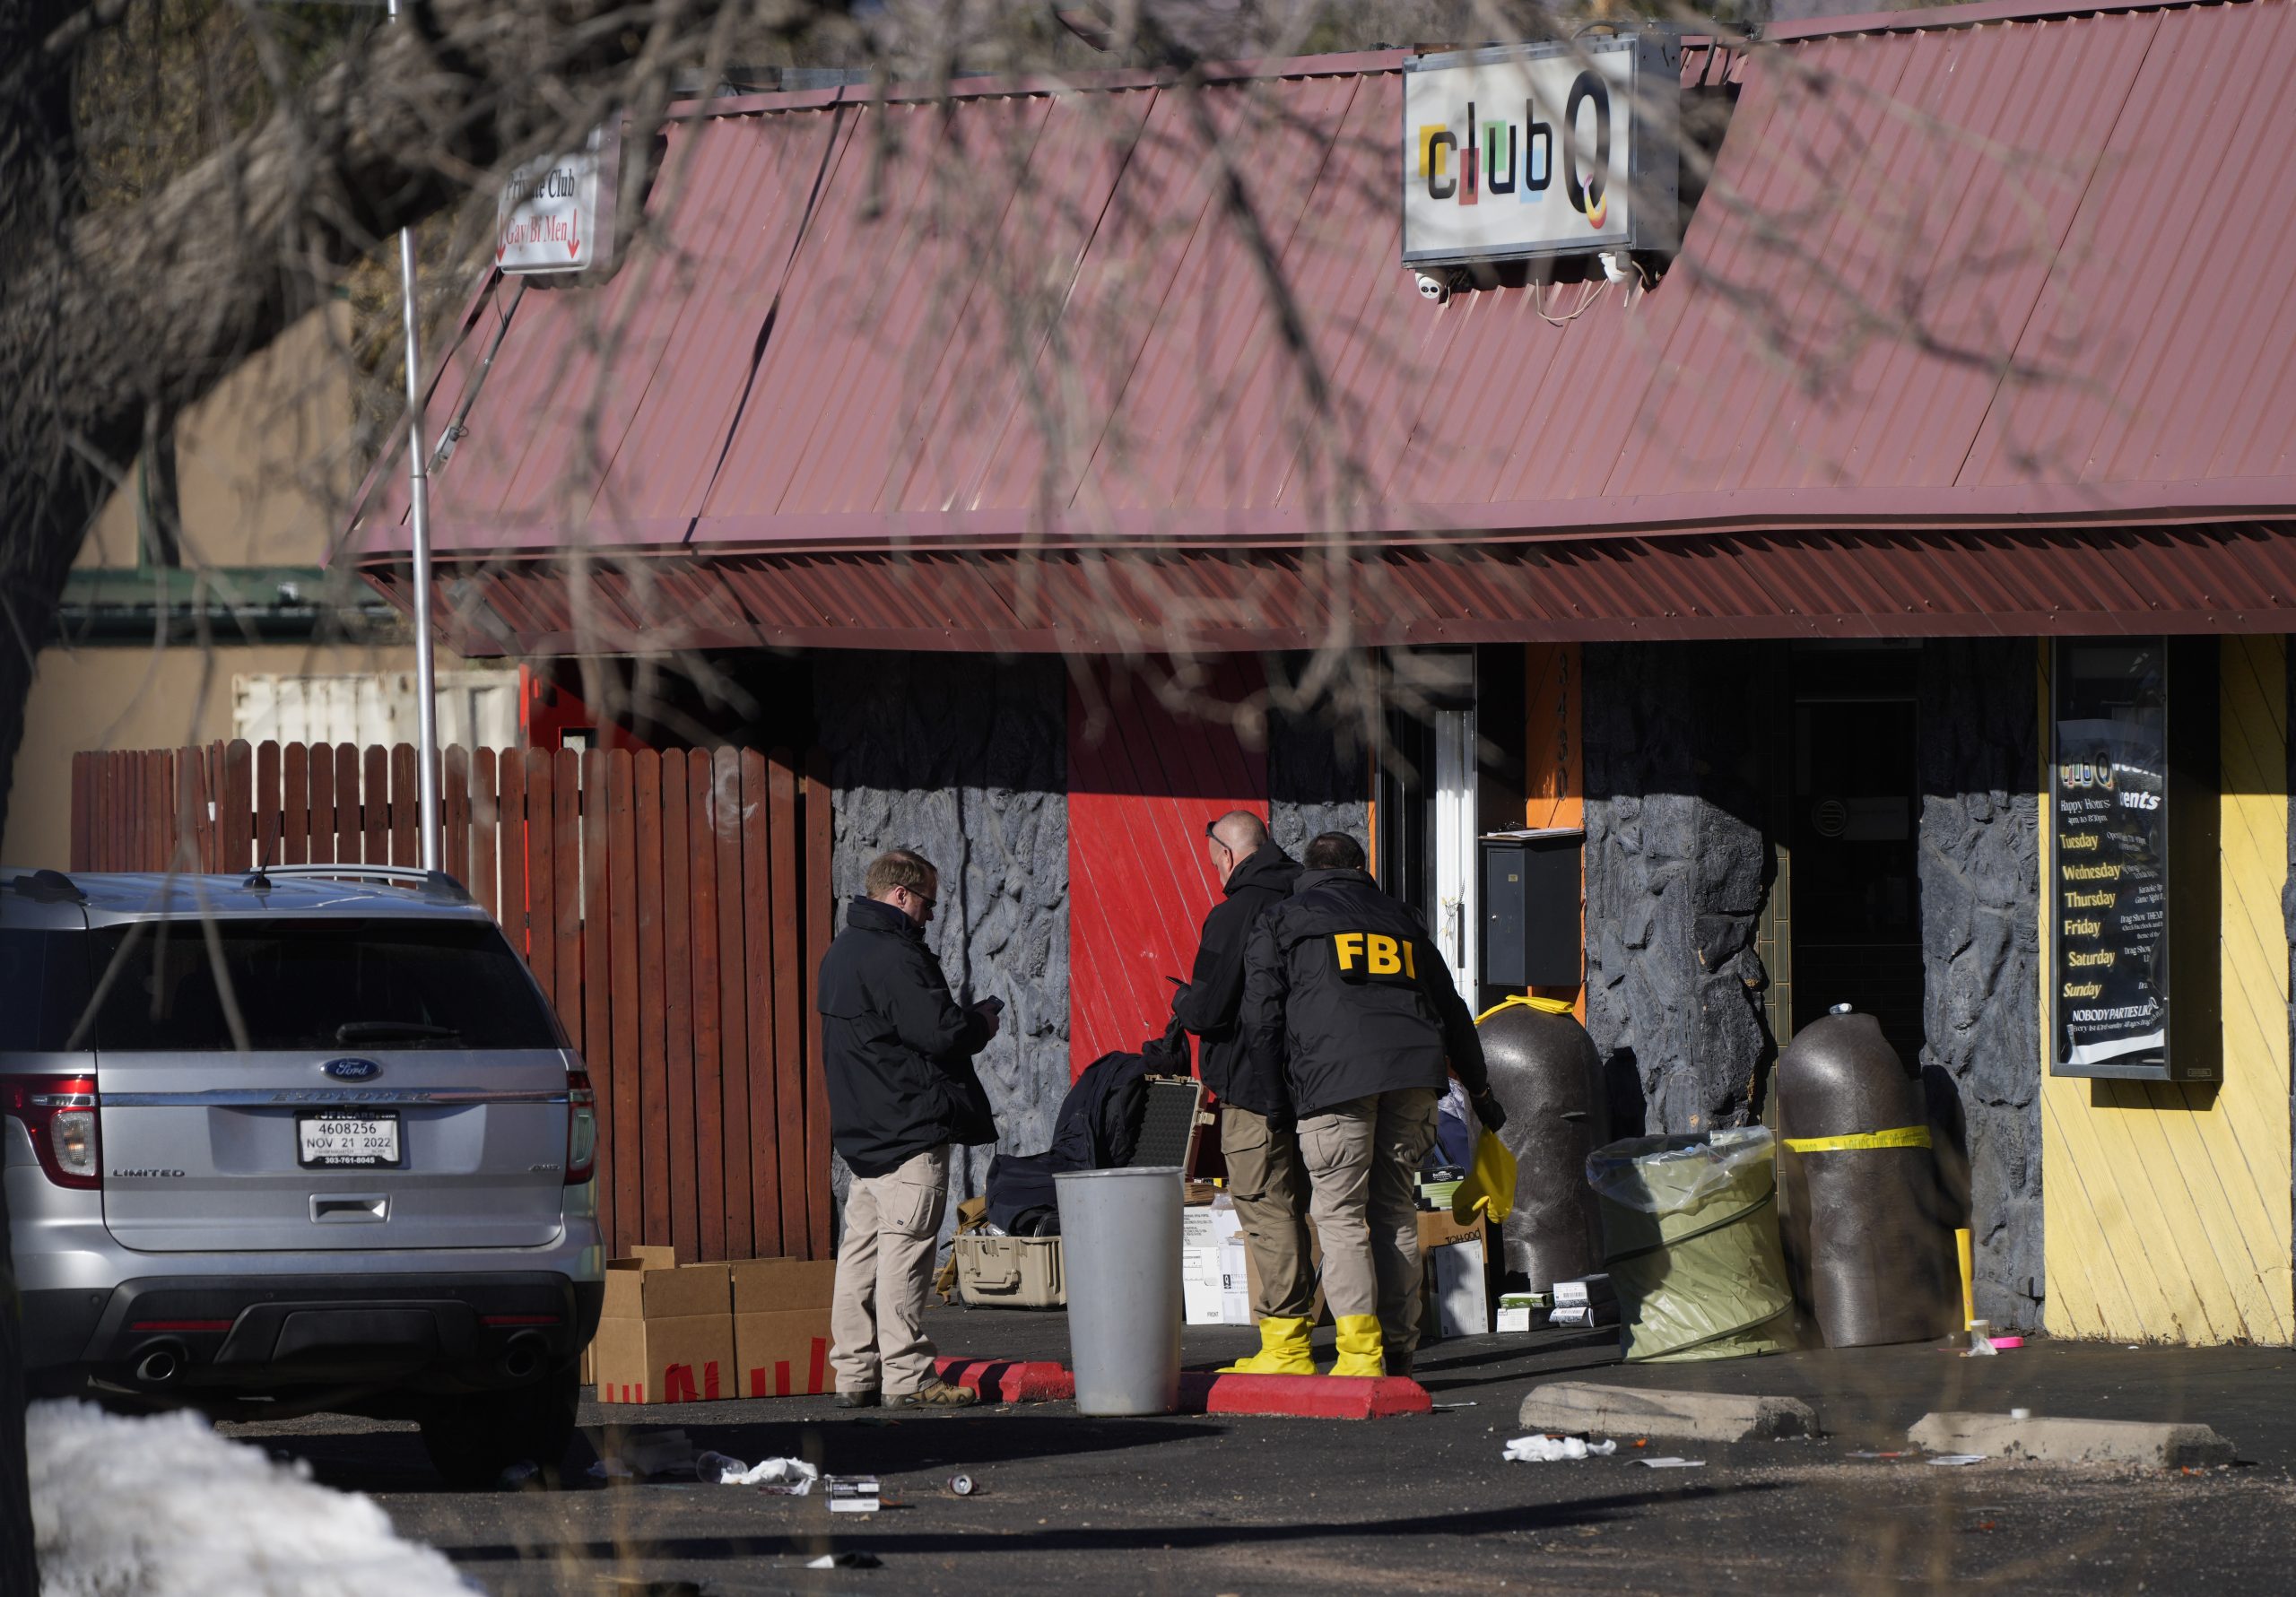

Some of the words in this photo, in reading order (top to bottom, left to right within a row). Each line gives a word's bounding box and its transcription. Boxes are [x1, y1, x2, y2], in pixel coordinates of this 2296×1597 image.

[1428, 99, 1552, 200] club
[1563, 69, 1611, 230] Q
[548, 169, 575, 198] Club
[544, 215, 568, 242] Men
[2060, 799, 2083, 813] Happy
[2080, 815, 2088, 823] to
[2059, 832, 2099, 851] Tuesday
[2062, 862, 2121, 881] Wednesday
[2065, 890, 2116, 908] Thursday
[2120, 915, 2133, 924] Drag
[2064, 918, 2101, 939] Friday
[1334, 933, 1416, 980] FBI
[2068, 949, 2116, 968] Saturday
[2125, 946, 2137, 956] Drag
[2063, 981, 2102, 999] Sunday
[2073, 1008, 2109, 1021] NOBODY
[2109, 1005, 2139, 1020] PARTIES
[335, 1061, 369, 1076] Ford
[272, 1091, 431, 1102] EXPLORER
[318, 1123, 377, 1134] 4608256
[307, 1138, 333, 1148] NOV
[342, 1138, 354, 1148] 21
[363, 1137, 391, 1148] 2022
[113, 1169, 186, 1177] LIMITED
